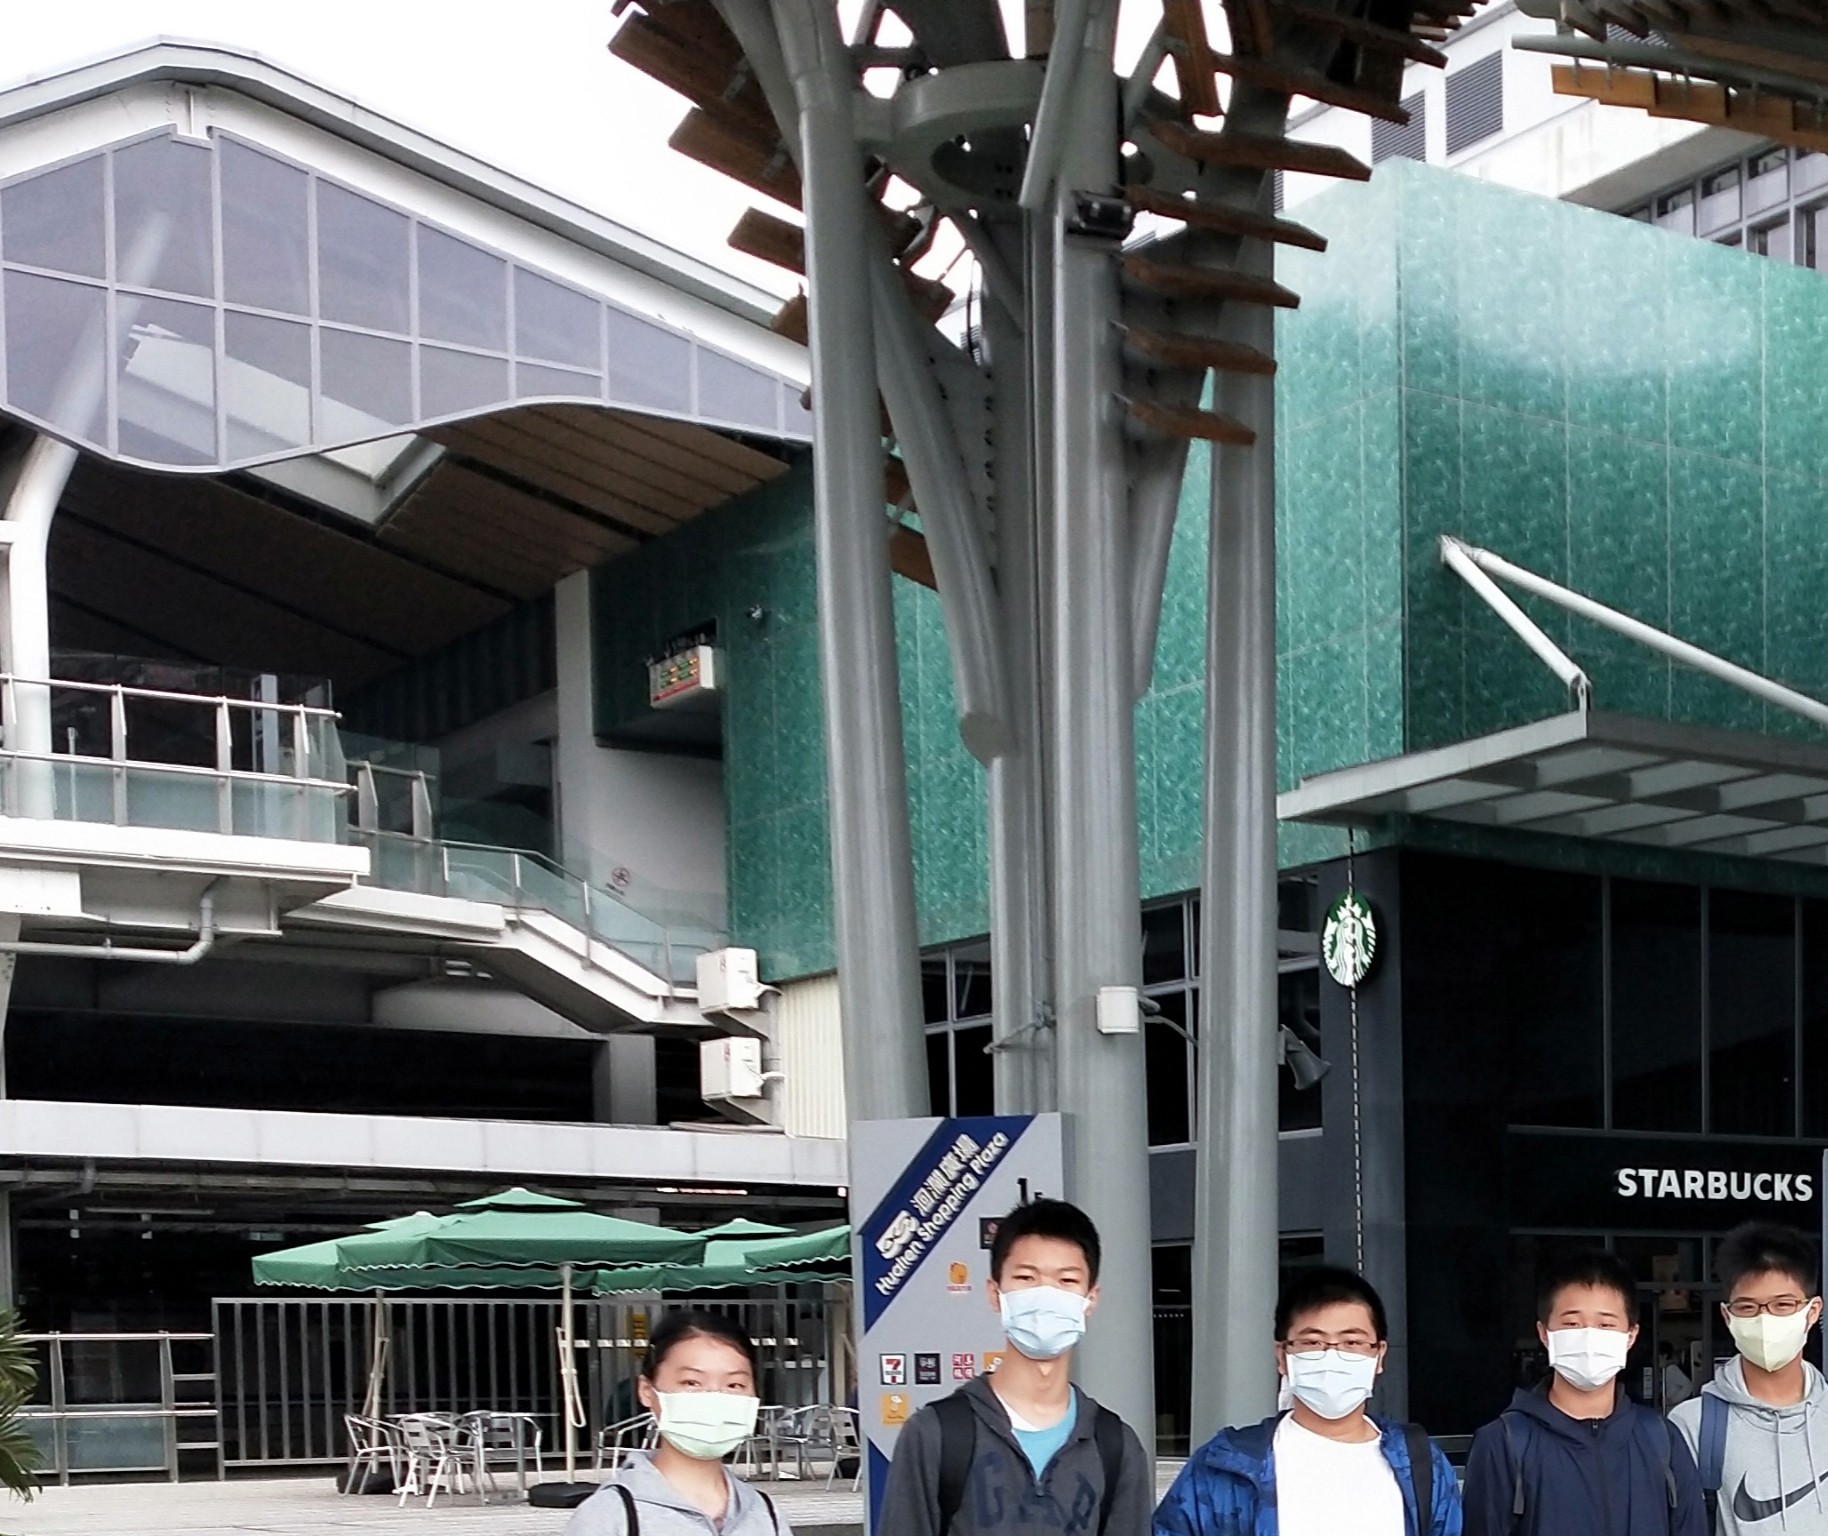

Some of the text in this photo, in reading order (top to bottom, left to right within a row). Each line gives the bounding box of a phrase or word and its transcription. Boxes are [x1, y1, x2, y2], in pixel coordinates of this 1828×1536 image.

[875, 1240, 926, 1296] Hualien
[917, 1172, 980, 1242] Shopping
[970, 1131, 1010, 1175] Plaza
[1617, 1168, 1813, 1202] STARBUCKS
